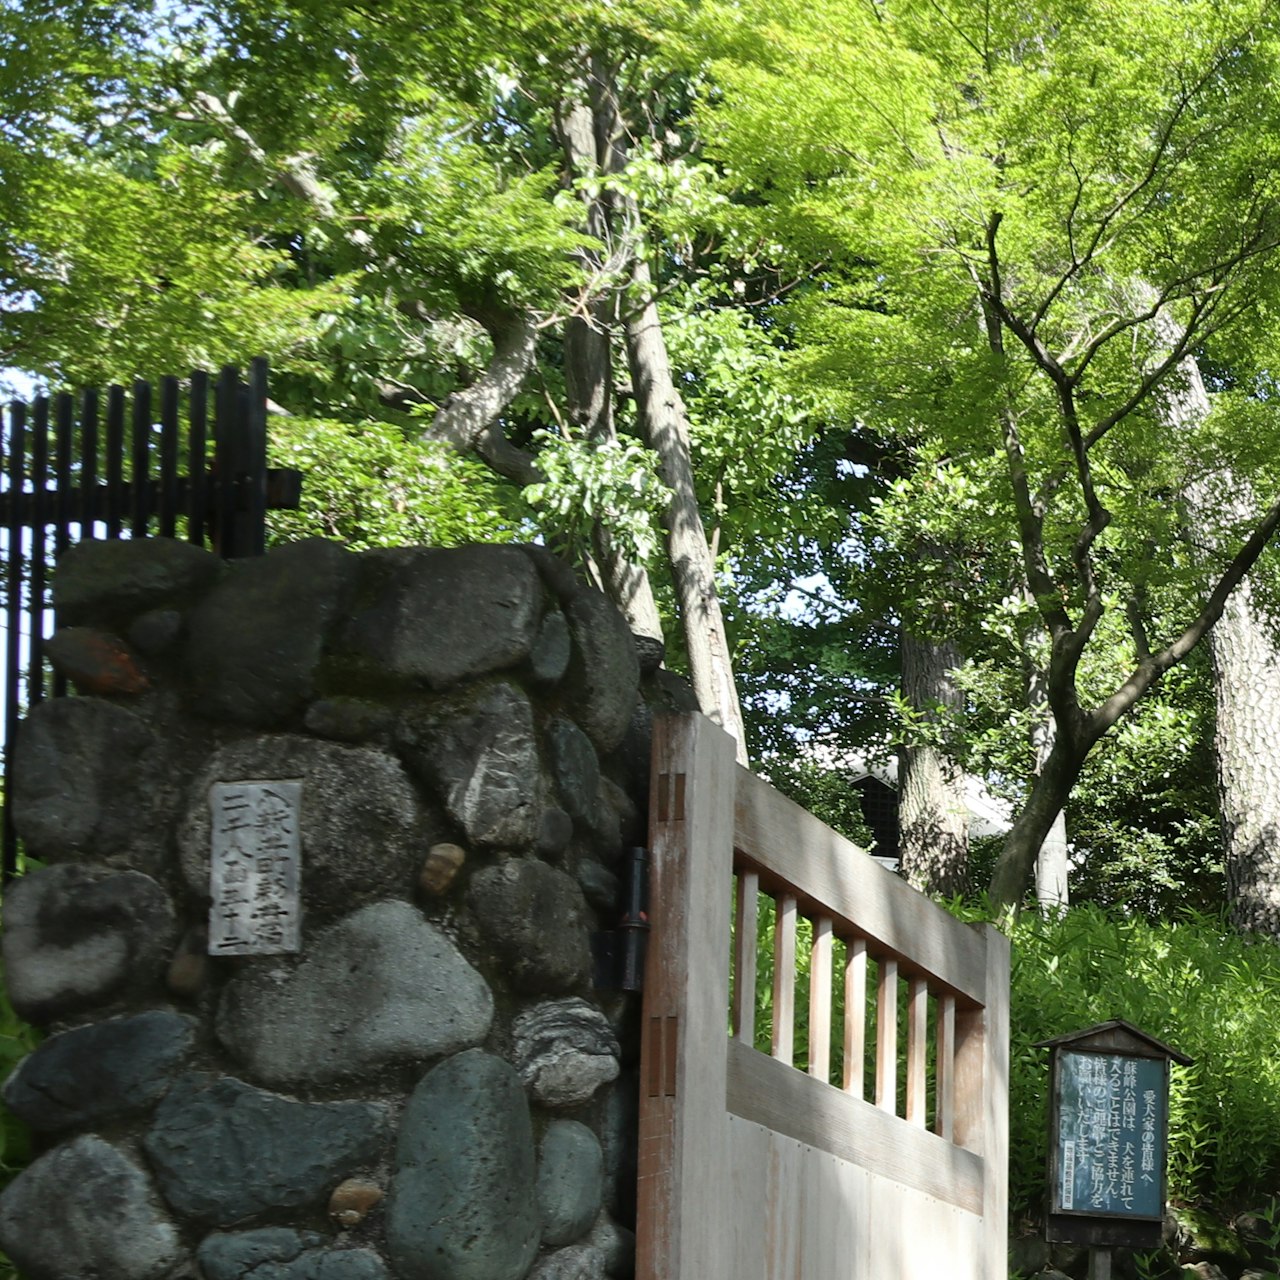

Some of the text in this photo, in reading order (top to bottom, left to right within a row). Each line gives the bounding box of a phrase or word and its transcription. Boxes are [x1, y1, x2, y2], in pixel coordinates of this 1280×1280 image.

[217, 795, 254, 948] 二千八百三十二
[1076, 1056, 1092, 1169] お願いいたします。
[1090, 1057, 1108, 1208] 皆様のご理解とご協力を
[1106, 1062, 1122, 1199] 入ることはできません。
[1141, 1090, 1157, 1183] 愛犬家の皆様へ
